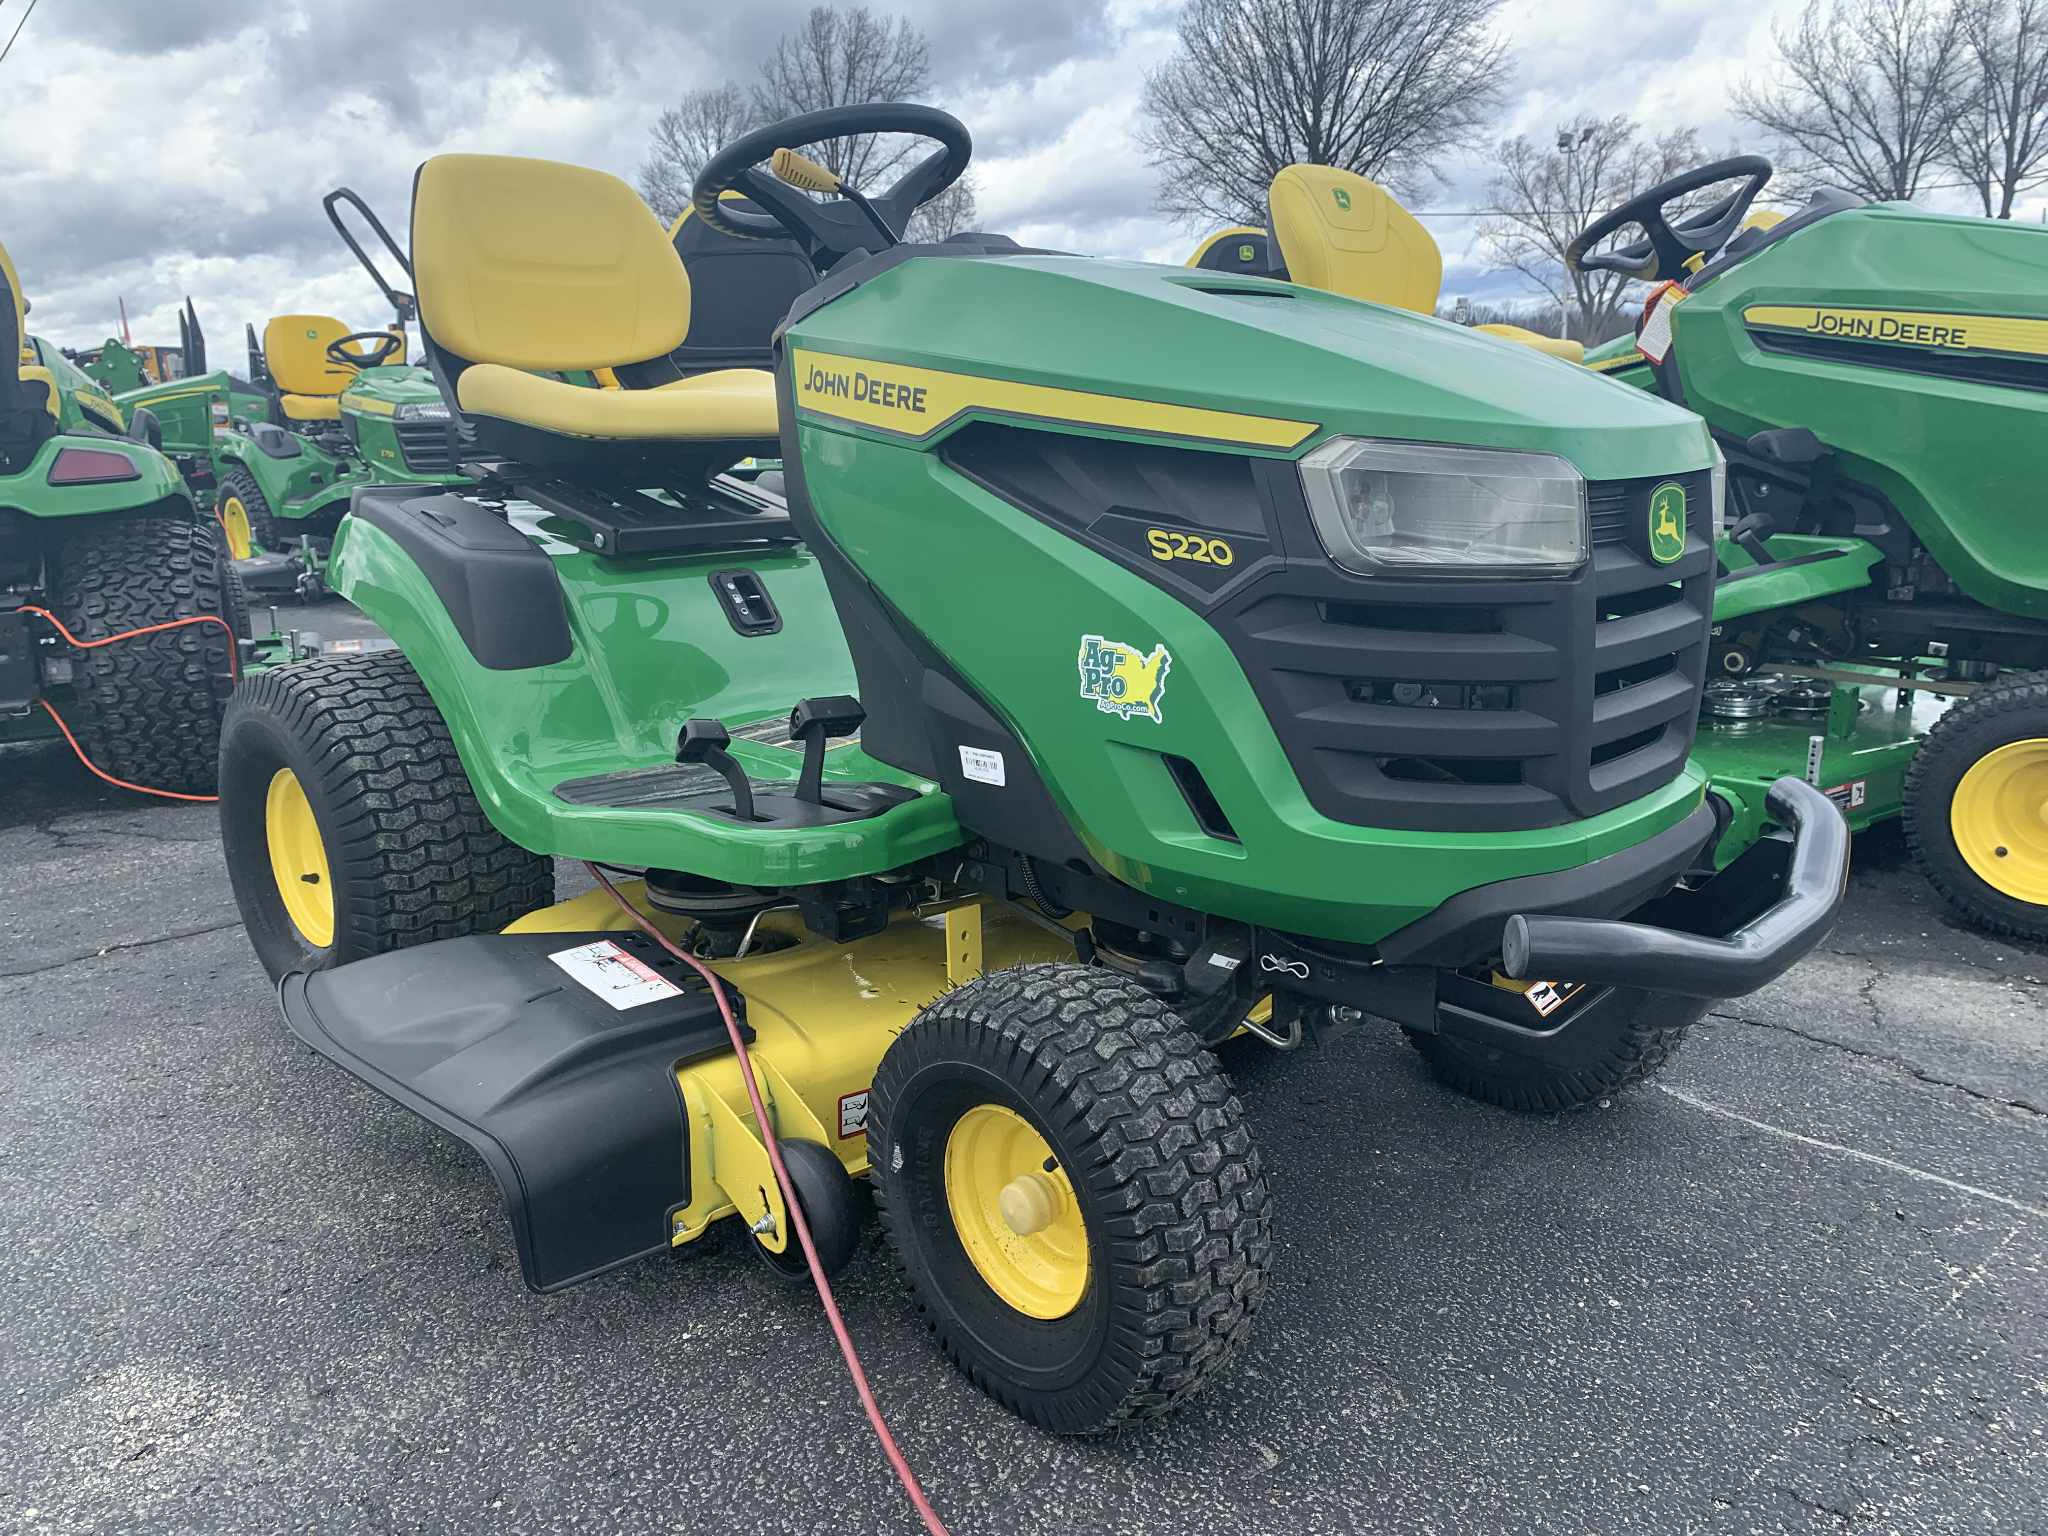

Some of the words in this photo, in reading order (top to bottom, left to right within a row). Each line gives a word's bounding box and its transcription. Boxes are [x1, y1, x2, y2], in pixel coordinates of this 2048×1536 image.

[1807, 311, 1873, 336] JOHN
[1879, 317, 1967, 345] DEERE
[804, 363, 850, 399] JOHN
[853, 371, 928, 414] DEERE
[1147, 529, 1234, 567] S220
[1084, 667, 1127, 697] Pro
